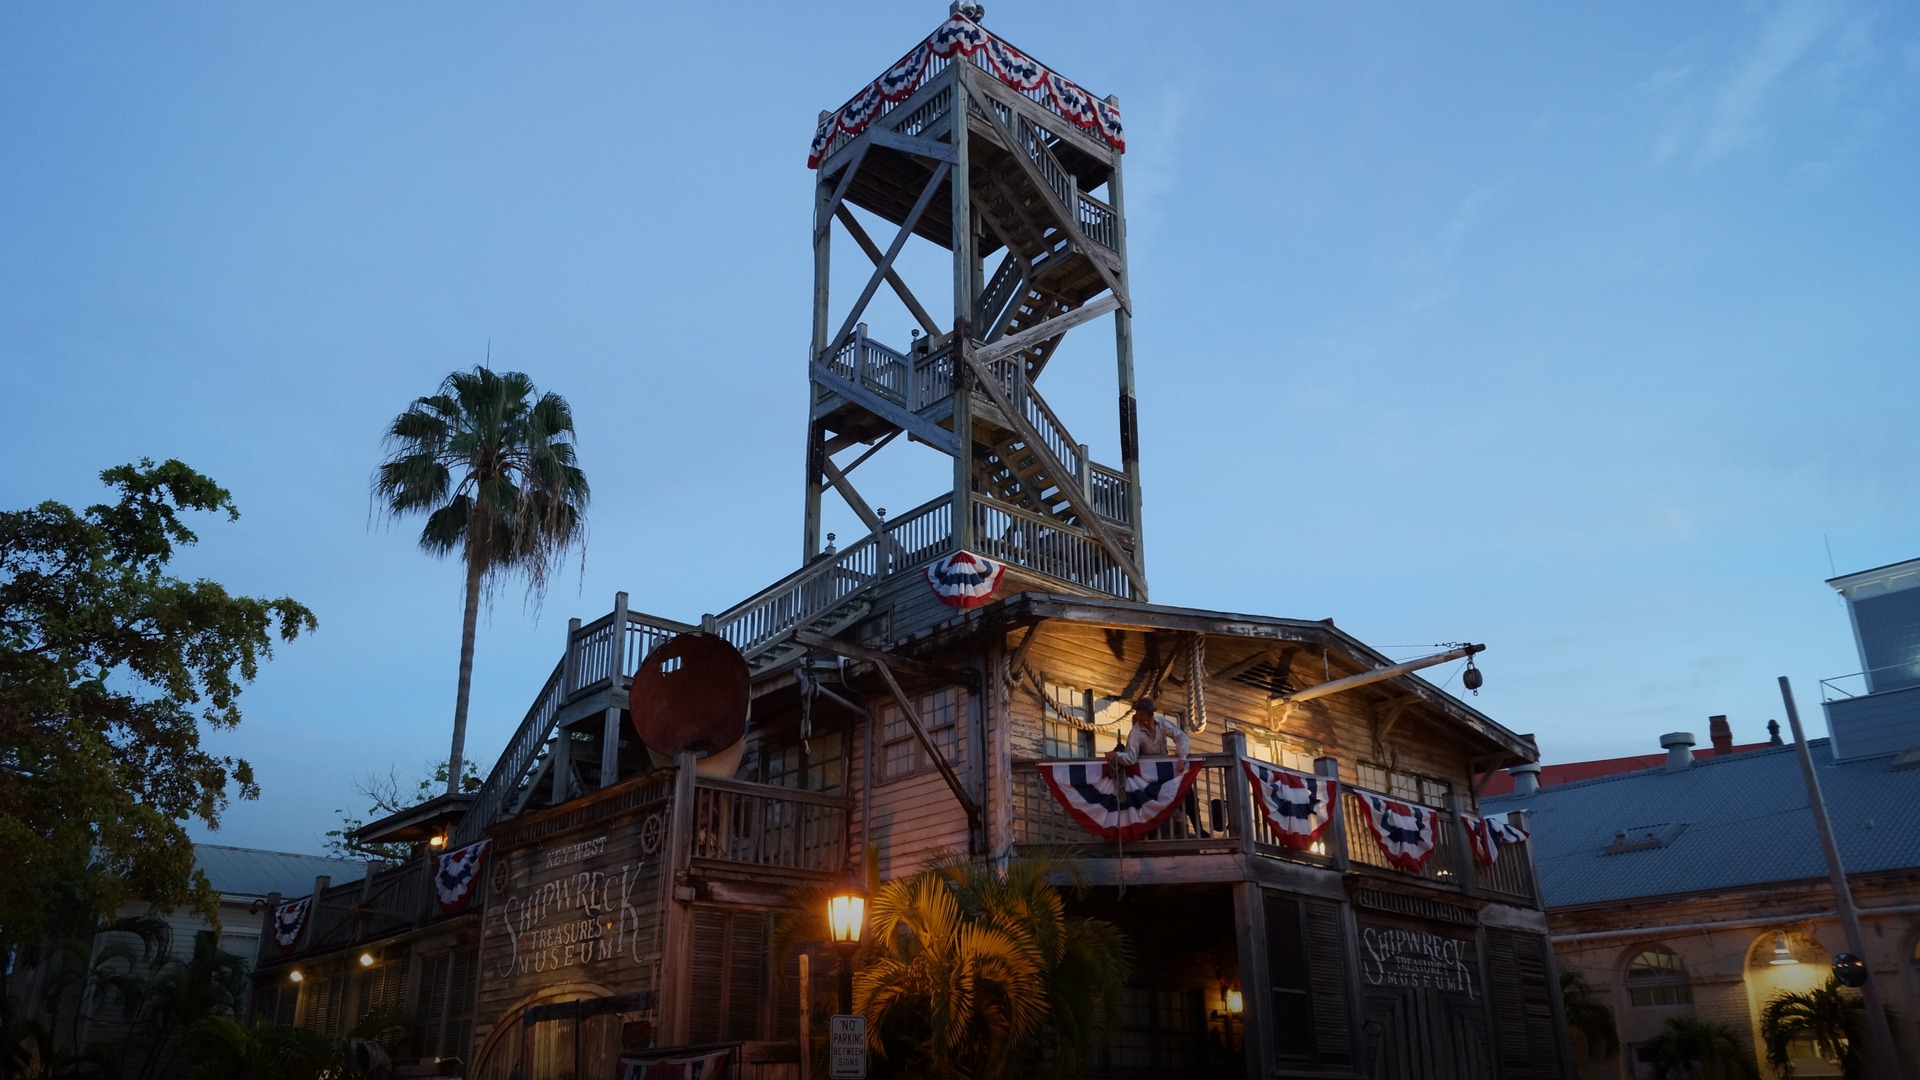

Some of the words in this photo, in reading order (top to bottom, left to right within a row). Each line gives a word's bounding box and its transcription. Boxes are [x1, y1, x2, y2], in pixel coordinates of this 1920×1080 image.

[545, 848, 571, 869] KEY
[574, 836, 607, 860] WEST
[498, 861, 645, 978] SHIPWRECK
[531, 915, 604, 950] TREASURES
[516, 938, 613, 975] MUSEUM
[1363, 927, 1475, 1000] SHIPWRECK
[1395, 956, 1449, 976] TREASURES
[1387, 972, 1457, 991] MUSEUM
[833, 1033, 864, 1045] PARKING
[833, 1047, 864, 1056] BETWEEN
[838, 1058, 859, 1067] SIGNS
